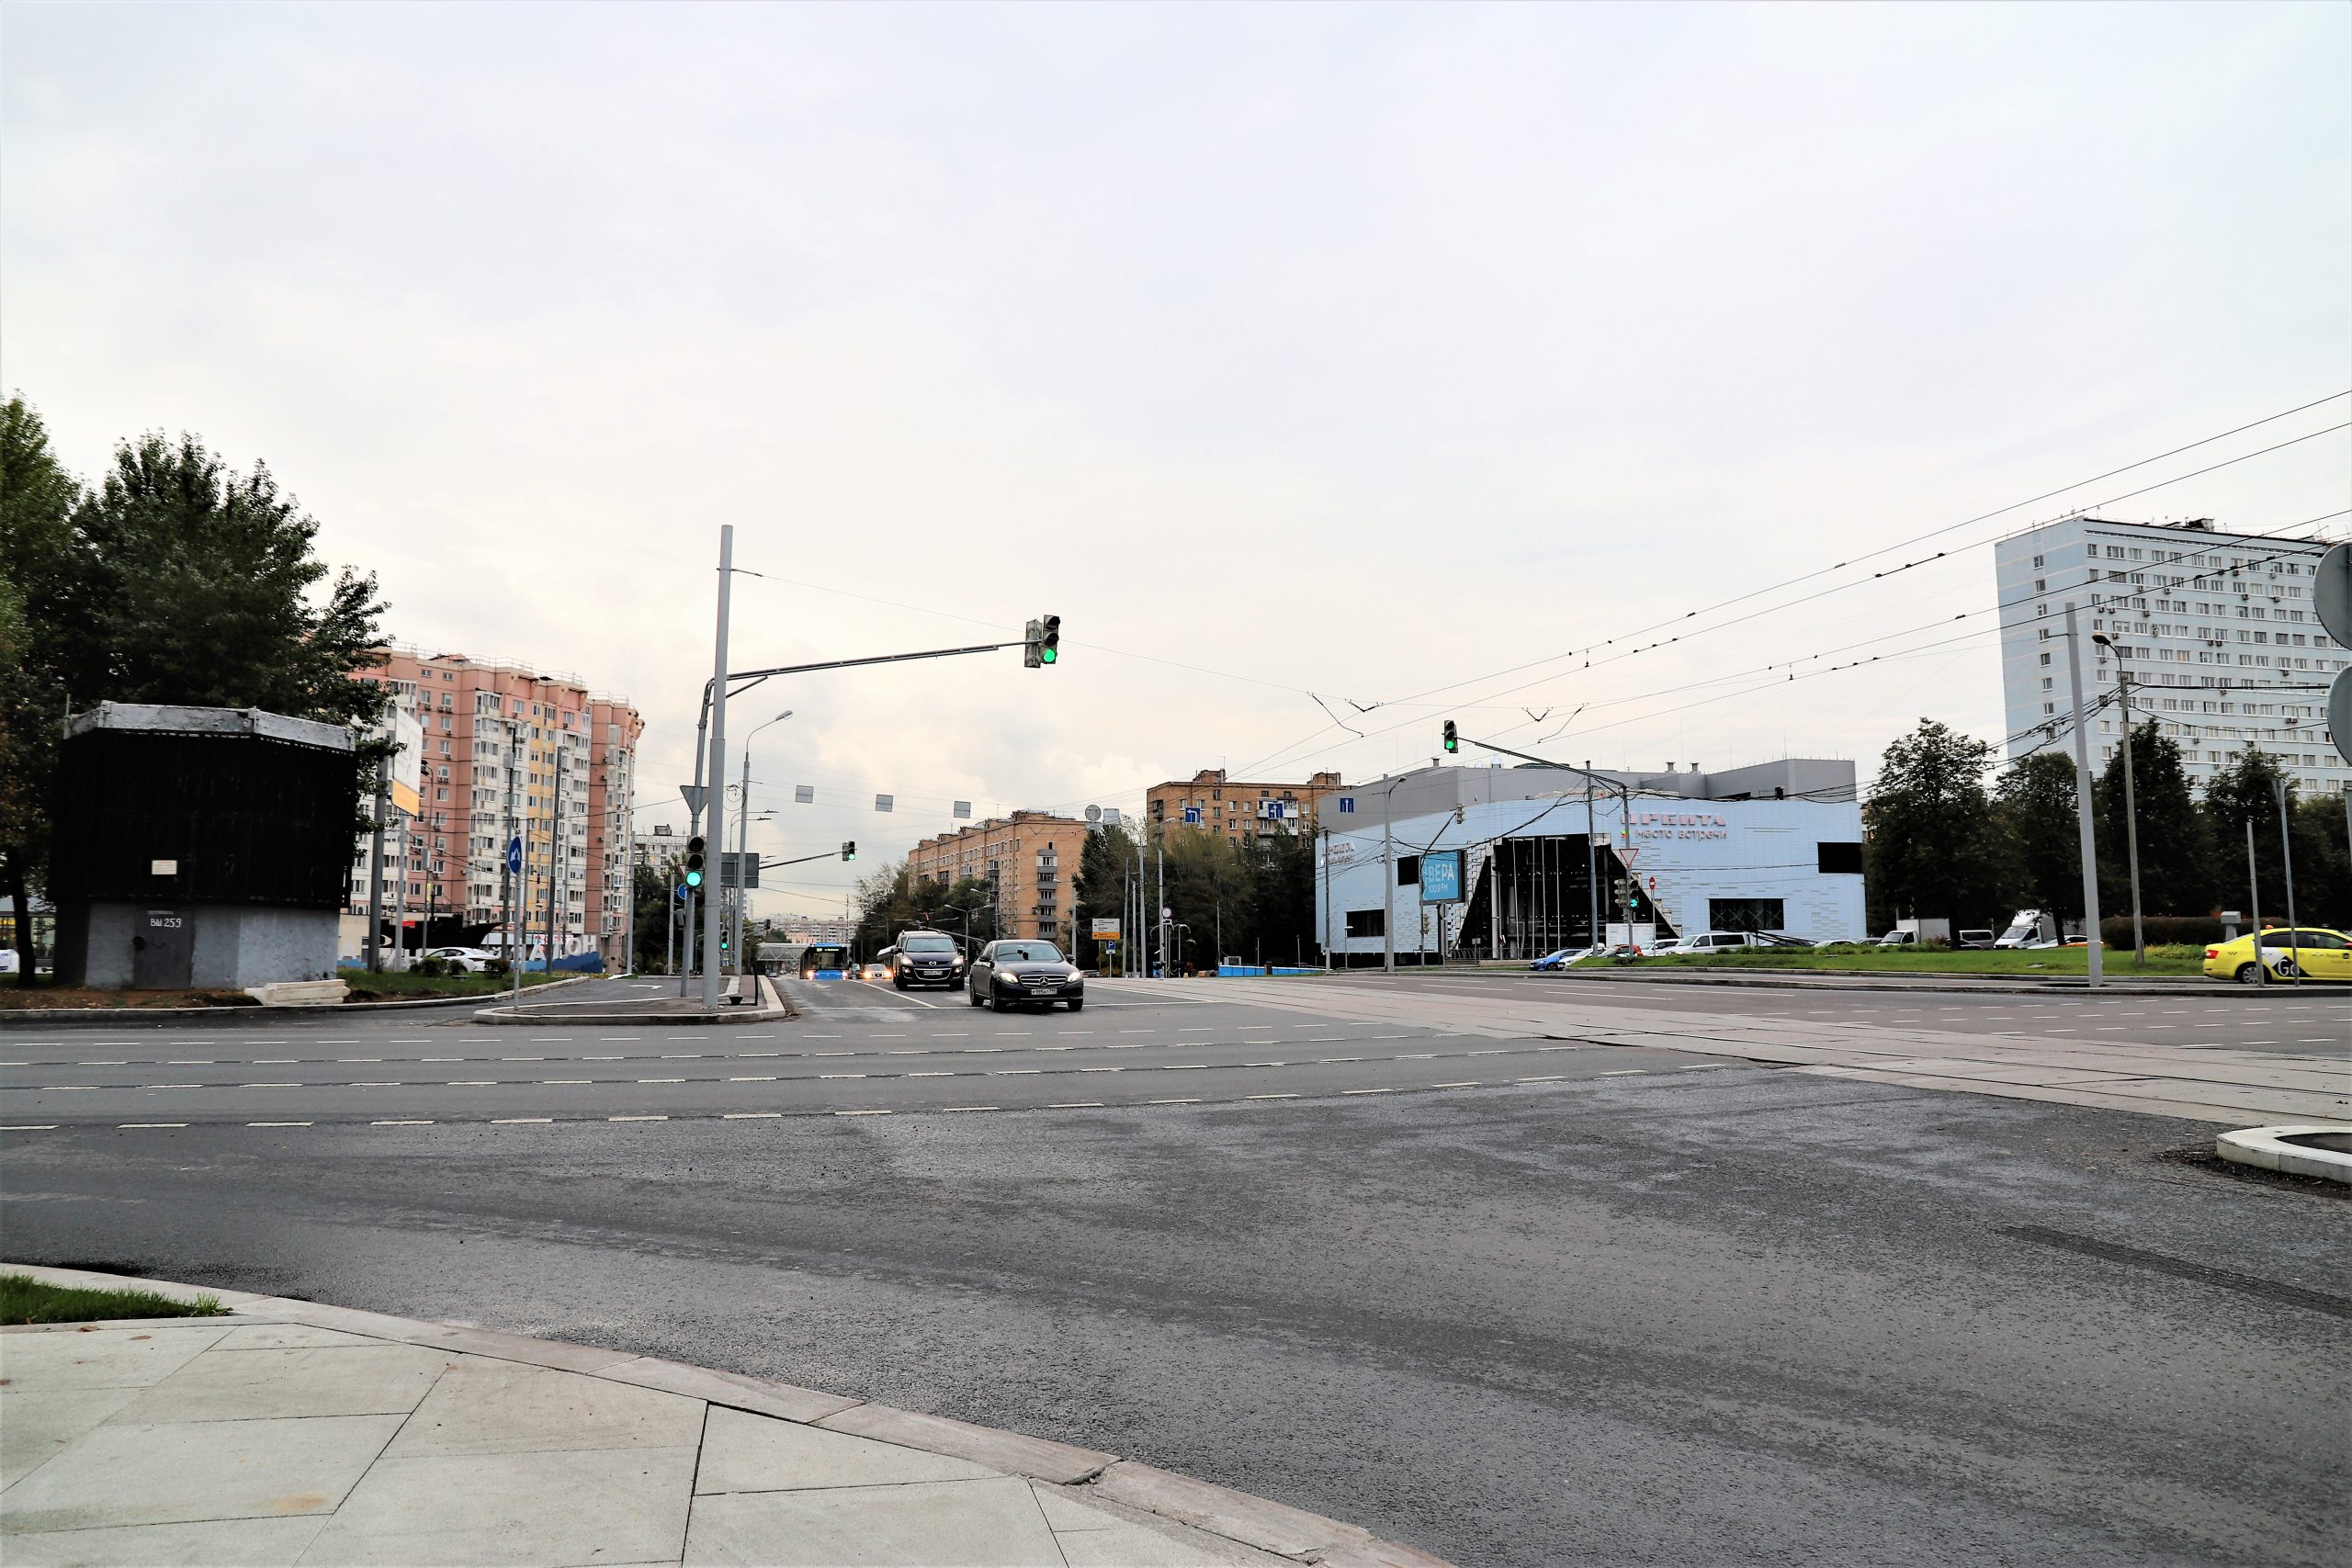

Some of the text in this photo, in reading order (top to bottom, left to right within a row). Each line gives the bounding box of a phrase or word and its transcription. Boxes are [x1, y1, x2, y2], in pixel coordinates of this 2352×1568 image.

[1636, 829, 1727, 842] место встречи
[164, 918, 182, 929] 259
